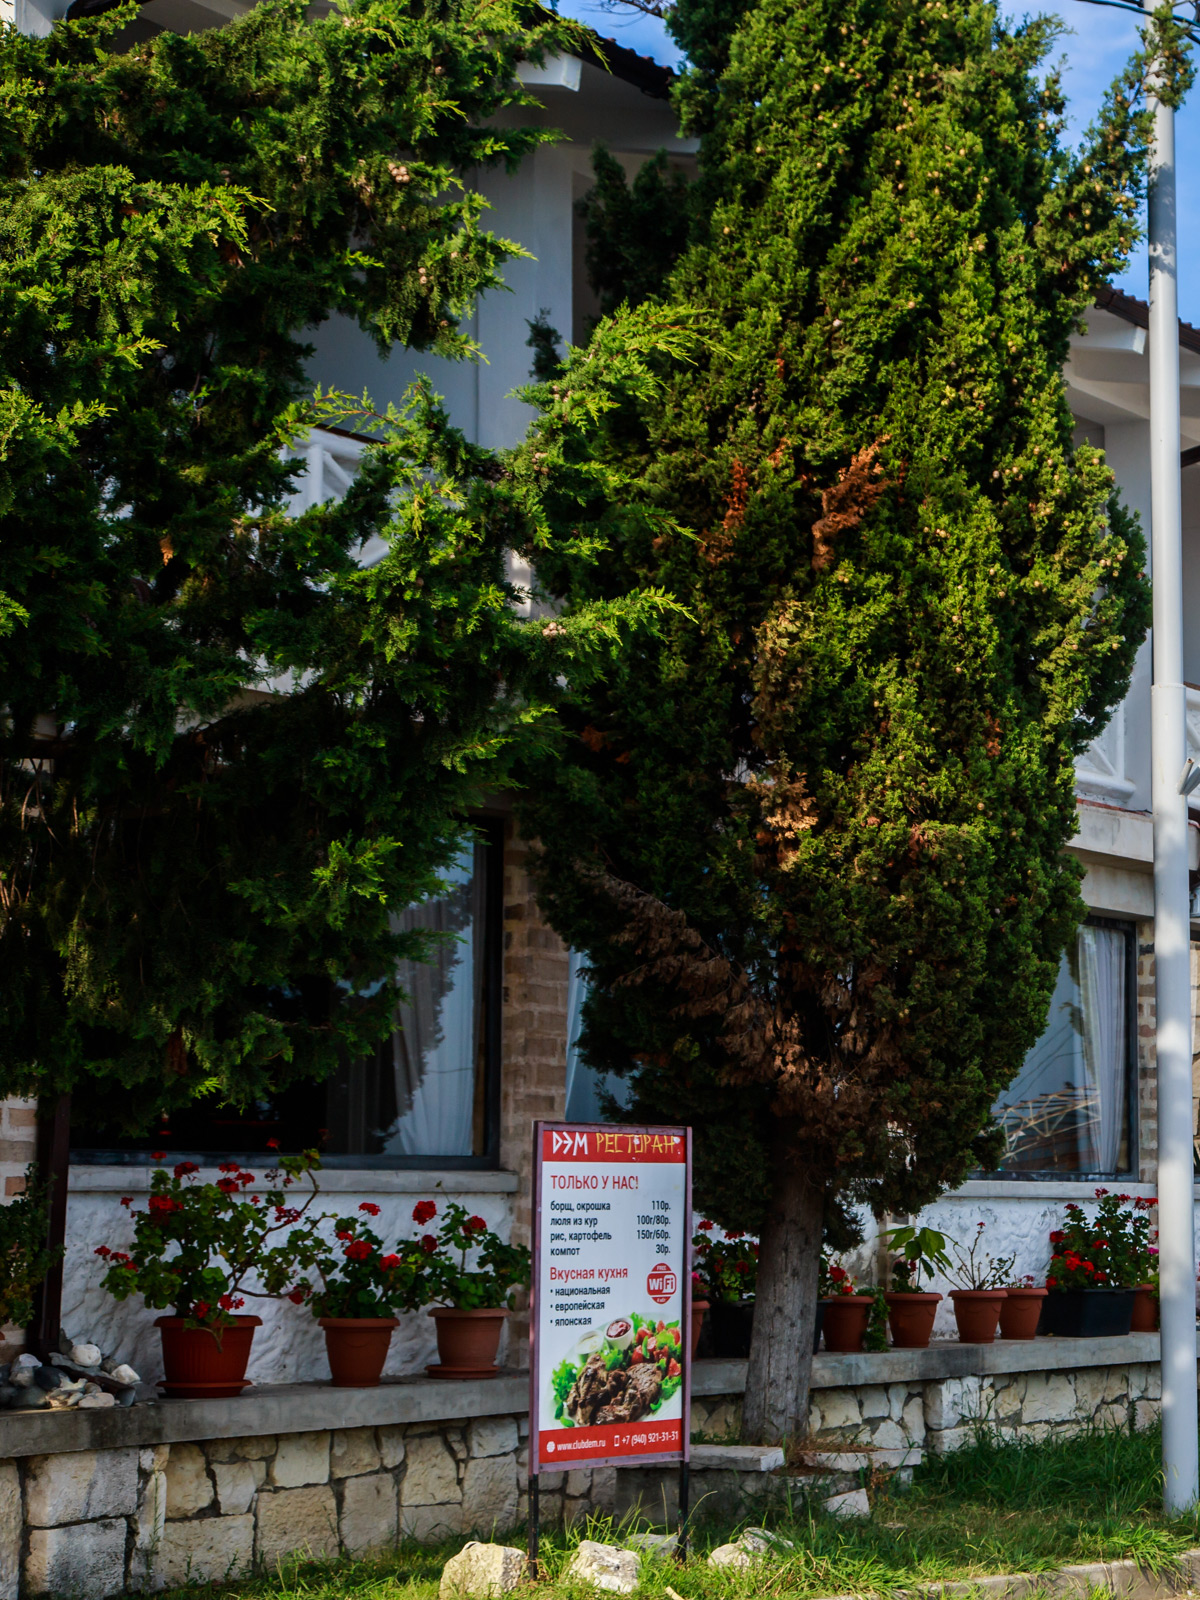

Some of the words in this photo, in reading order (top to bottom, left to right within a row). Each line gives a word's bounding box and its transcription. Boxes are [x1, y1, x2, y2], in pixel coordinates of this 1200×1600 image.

[596, 1132, 675, 1154] РЕСТОРАН
[550, 1175, 599, 1190] ТОЛЬКО
[601, 1175, 609, 1190] У
[612, 1176, 639, 1190] НАС!
[550, 1200, 575, 1213] борщ,
[576, 1203, 611, 1213] окрошка
[651, 1200, 671, 1213] 110р.
[550, 1217, 571, 1226] люля
[573, 1217, 582, 1226] из
[584, 1217, 598, 1228] кур
[636, 1215, 671, 1227] 100г/80р.
[550, 1233, 567, 1243] рис,
[568, 1231, 612, 1242] картофель
[636, 1229, 671, 1242] 150г/60р.
[550, 1247, 580, 1256] компот
[655, 1244, 671, 1256] 30р.
[550, 1267, 595, 1283] Вкусная
[598, 1267, 628, 1282] кухня
[555, 1286, 611, 1297] национальная
[555, 1300, 605, 1313] европейская
[555, 1317, 592, 1327] японская
[557, 1438, 606, 1451] www.clubdem.ru
[622, 1435, 630, 1445] +7
[648, 1431, 679, 1443] 921-31-31
